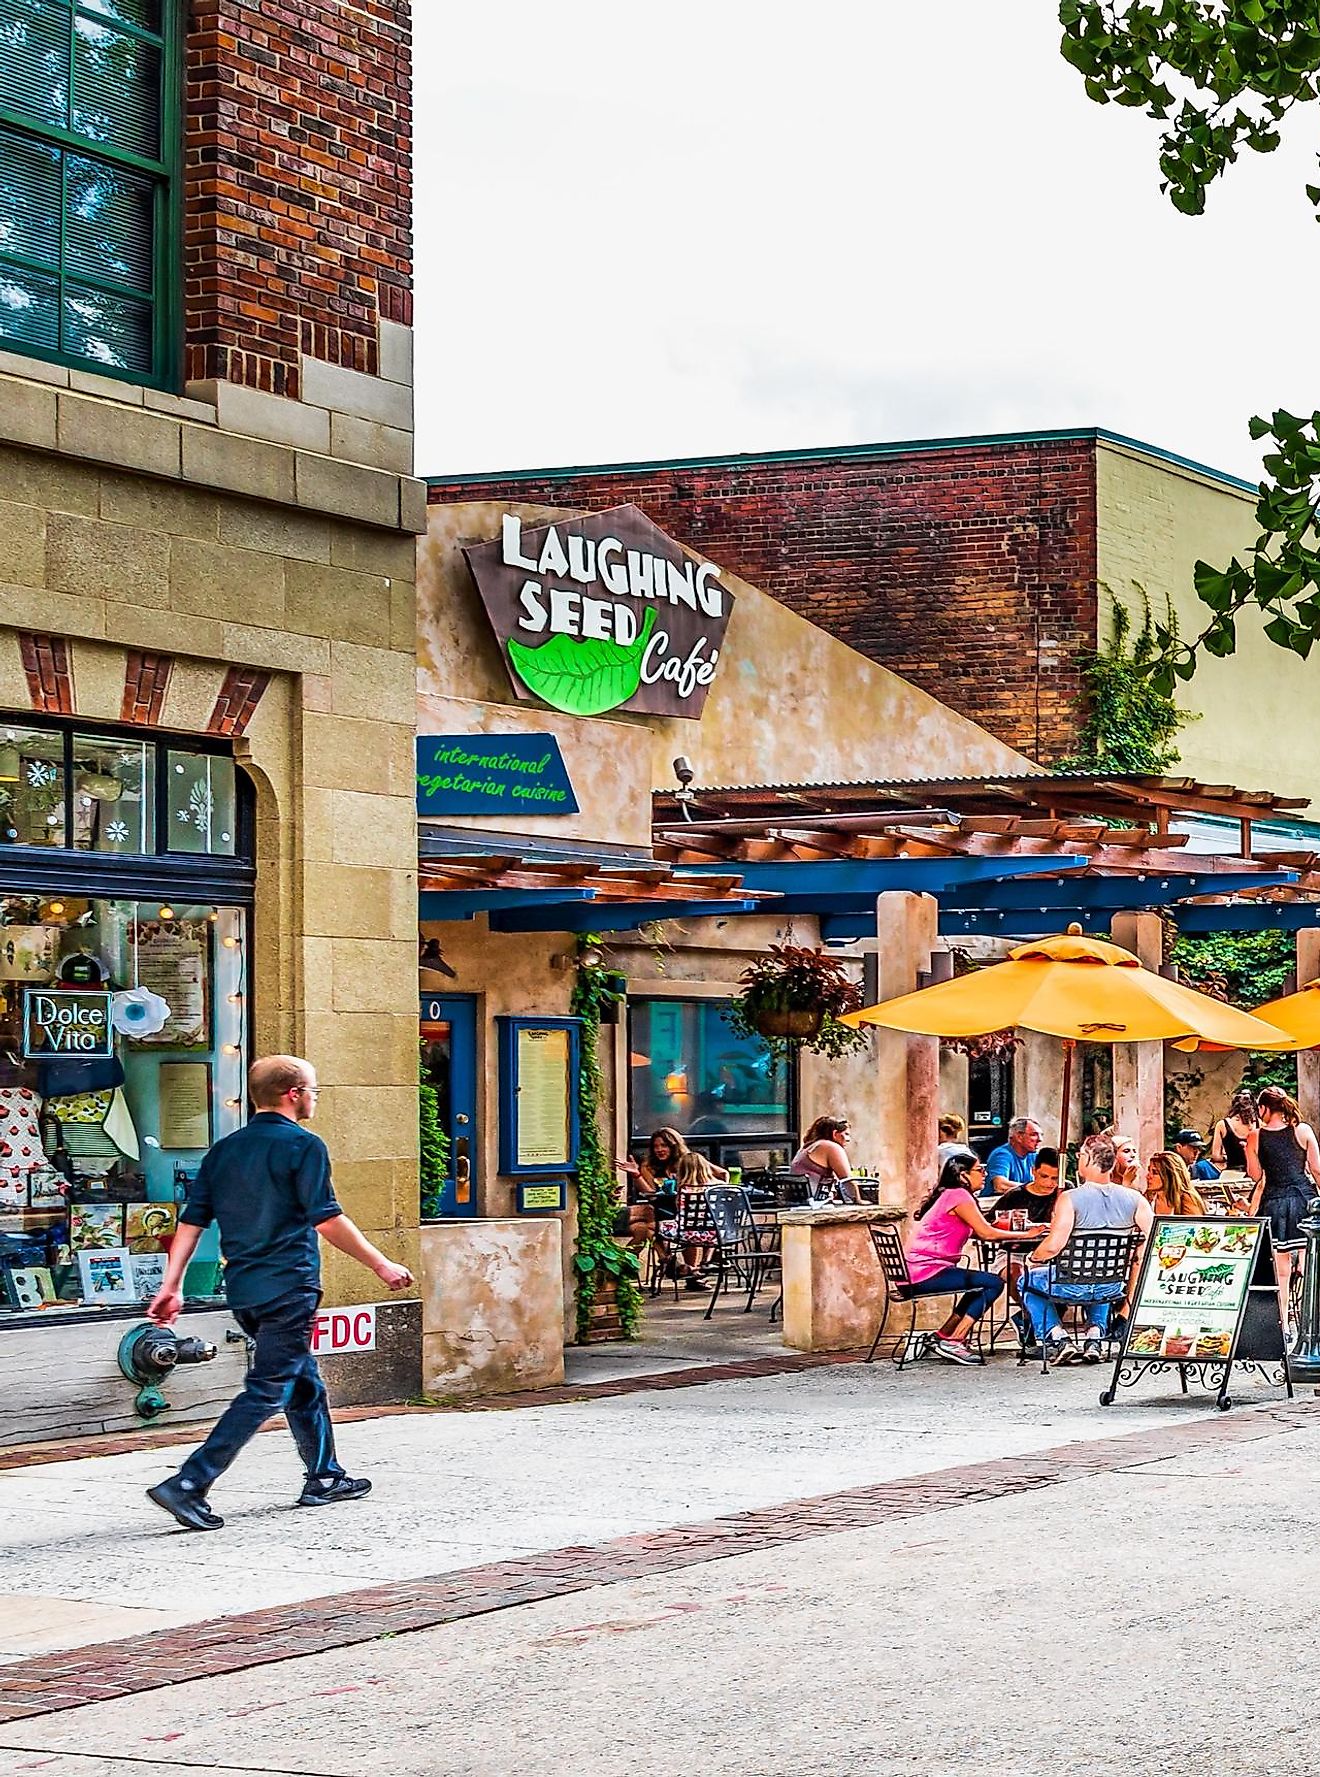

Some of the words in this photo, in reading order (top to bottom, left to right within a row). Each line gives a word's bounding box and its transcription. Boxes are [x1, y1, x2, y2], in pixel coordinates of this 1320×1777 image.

[502, 513, 723, 618] LAUGHING
[519, 580, 637, 646] SEED
[433, 744, 552, 773] international
[416, 773, 506, 799] egetarian
[511, 781, 568, 803] cuisine
[36, 996, 104, 1026] Dolce
[44, 1025, 97, 1052] Vita
[1157, 1270, 1234, 1285] LAUGHING
[1165, 1284, 1206, 1295] SEED
[312, 1311, 373, 1351] FDC
